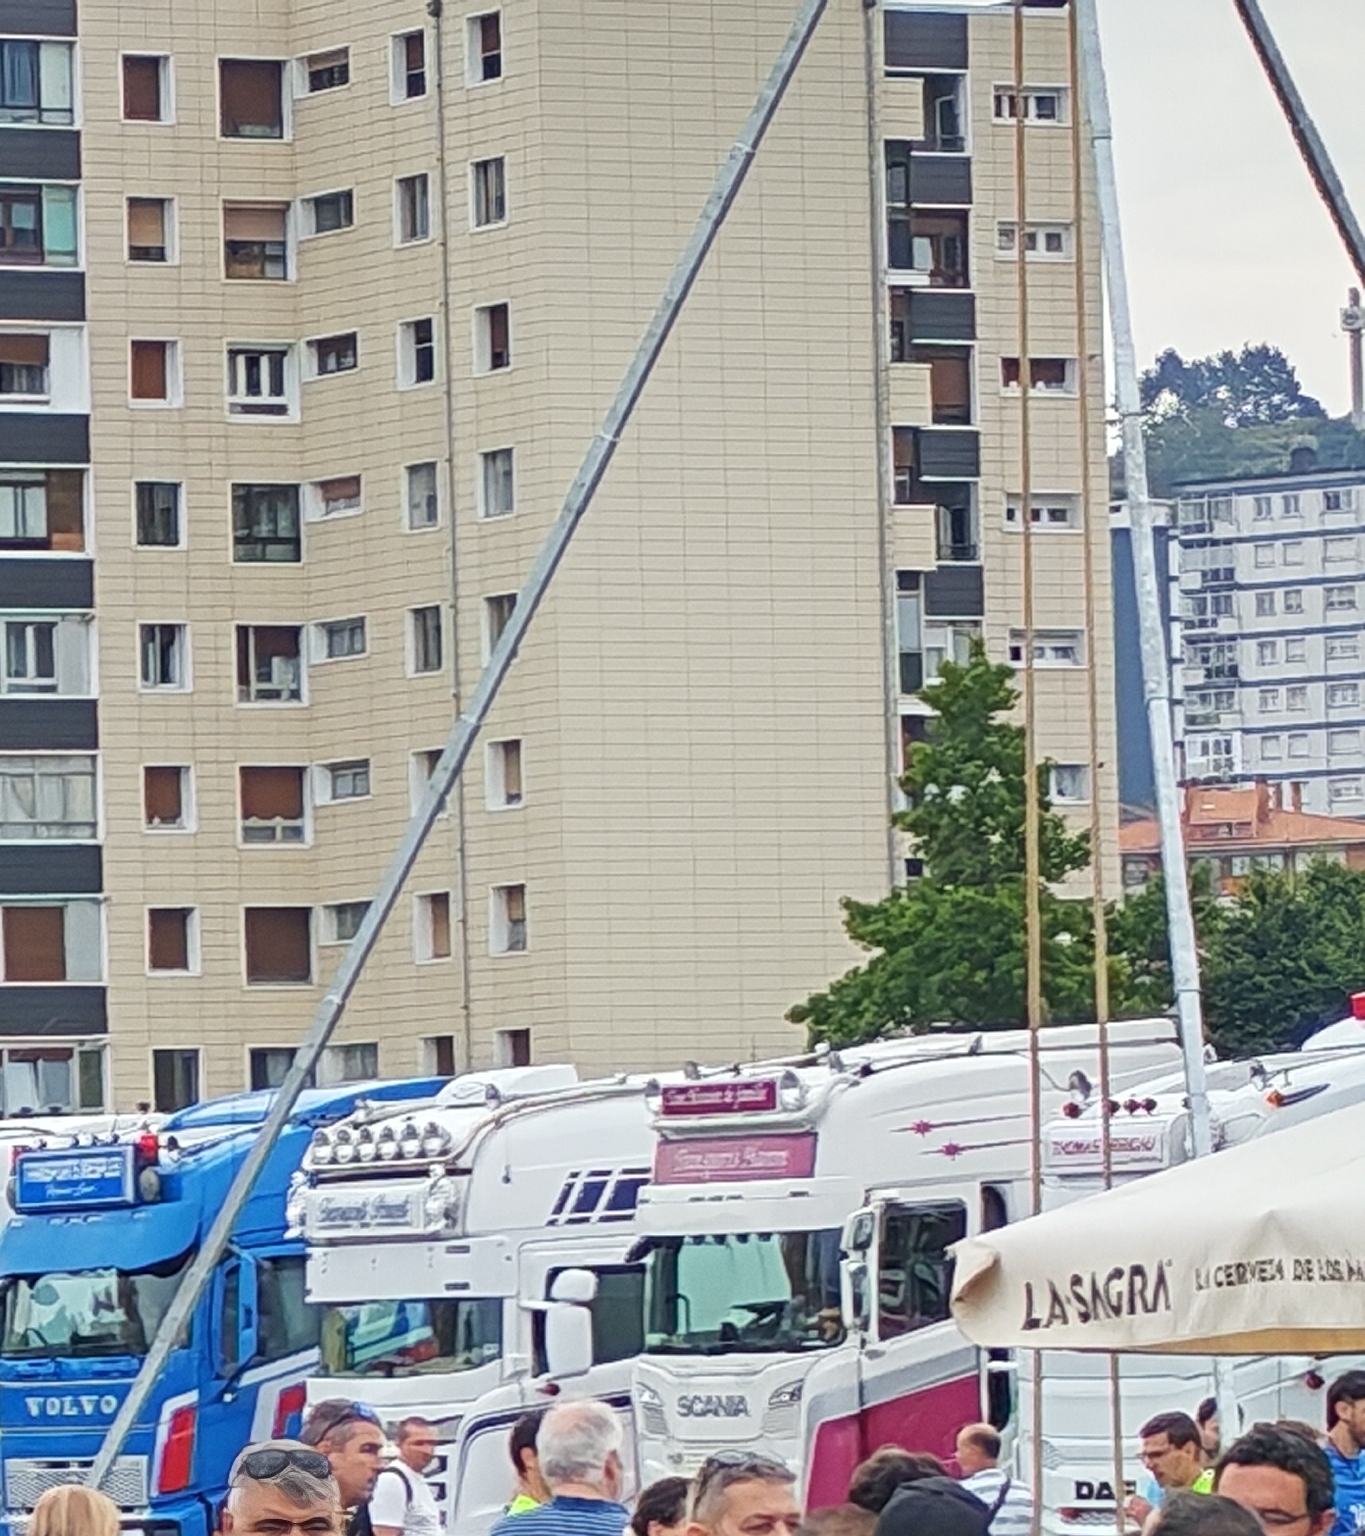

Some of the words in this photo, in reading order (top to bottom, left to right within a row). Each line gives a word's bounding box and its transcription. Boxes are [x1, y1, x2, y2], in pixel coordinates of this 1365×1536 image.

[1292, 1257, 1315, 1282] DE
[24, 1395, 118, 1417] VOLVO
[676, 1395, 753, 1418] SCANIA
